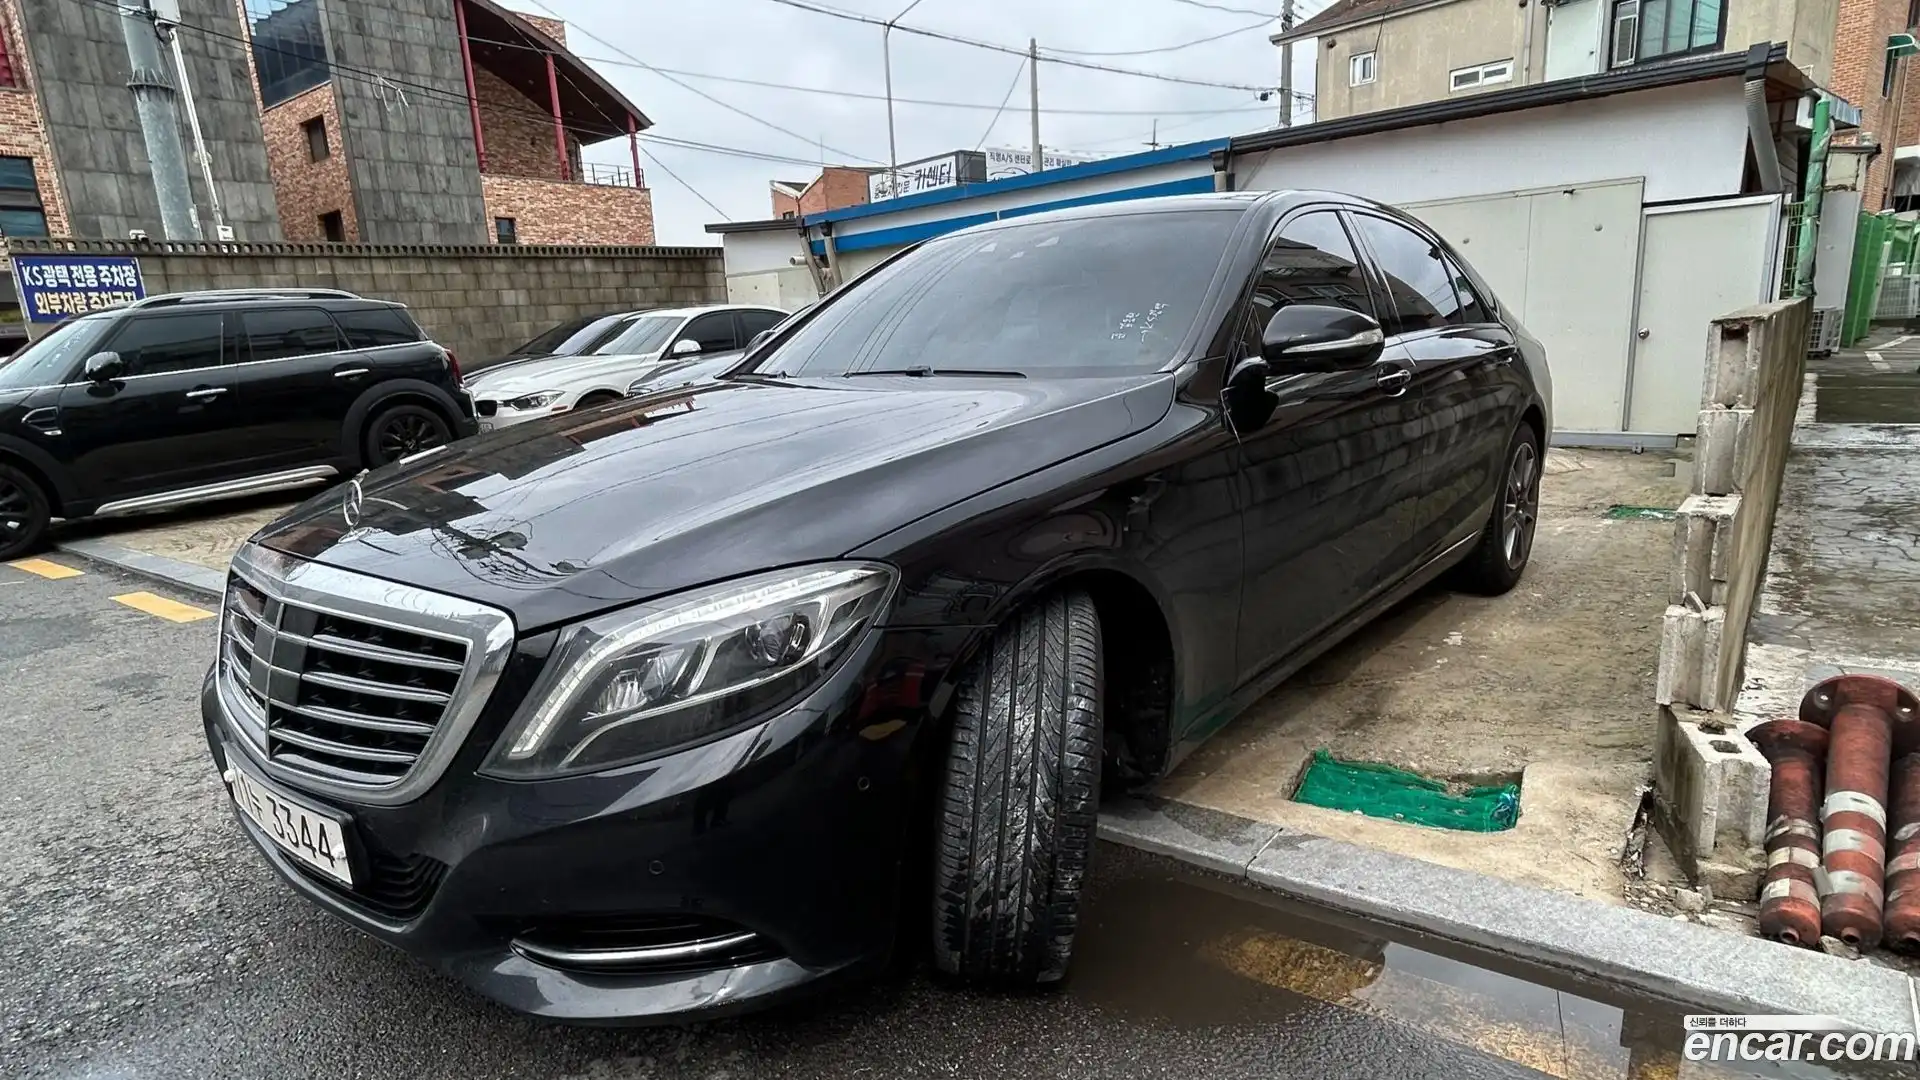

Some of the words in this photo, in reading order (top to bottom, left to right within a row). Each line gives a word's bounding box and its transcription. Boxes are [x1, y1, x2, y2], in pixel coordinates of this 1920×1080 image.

[914, 161, 952, 190] 카센터
[22, 264, 71, 288] KS광택
[70, 264, 98, 288] 전용
[98, 264, 137, 288] 주차장
[34, 291, 88, 314] 외부차량
[265, 794, 335, 869] 3344
